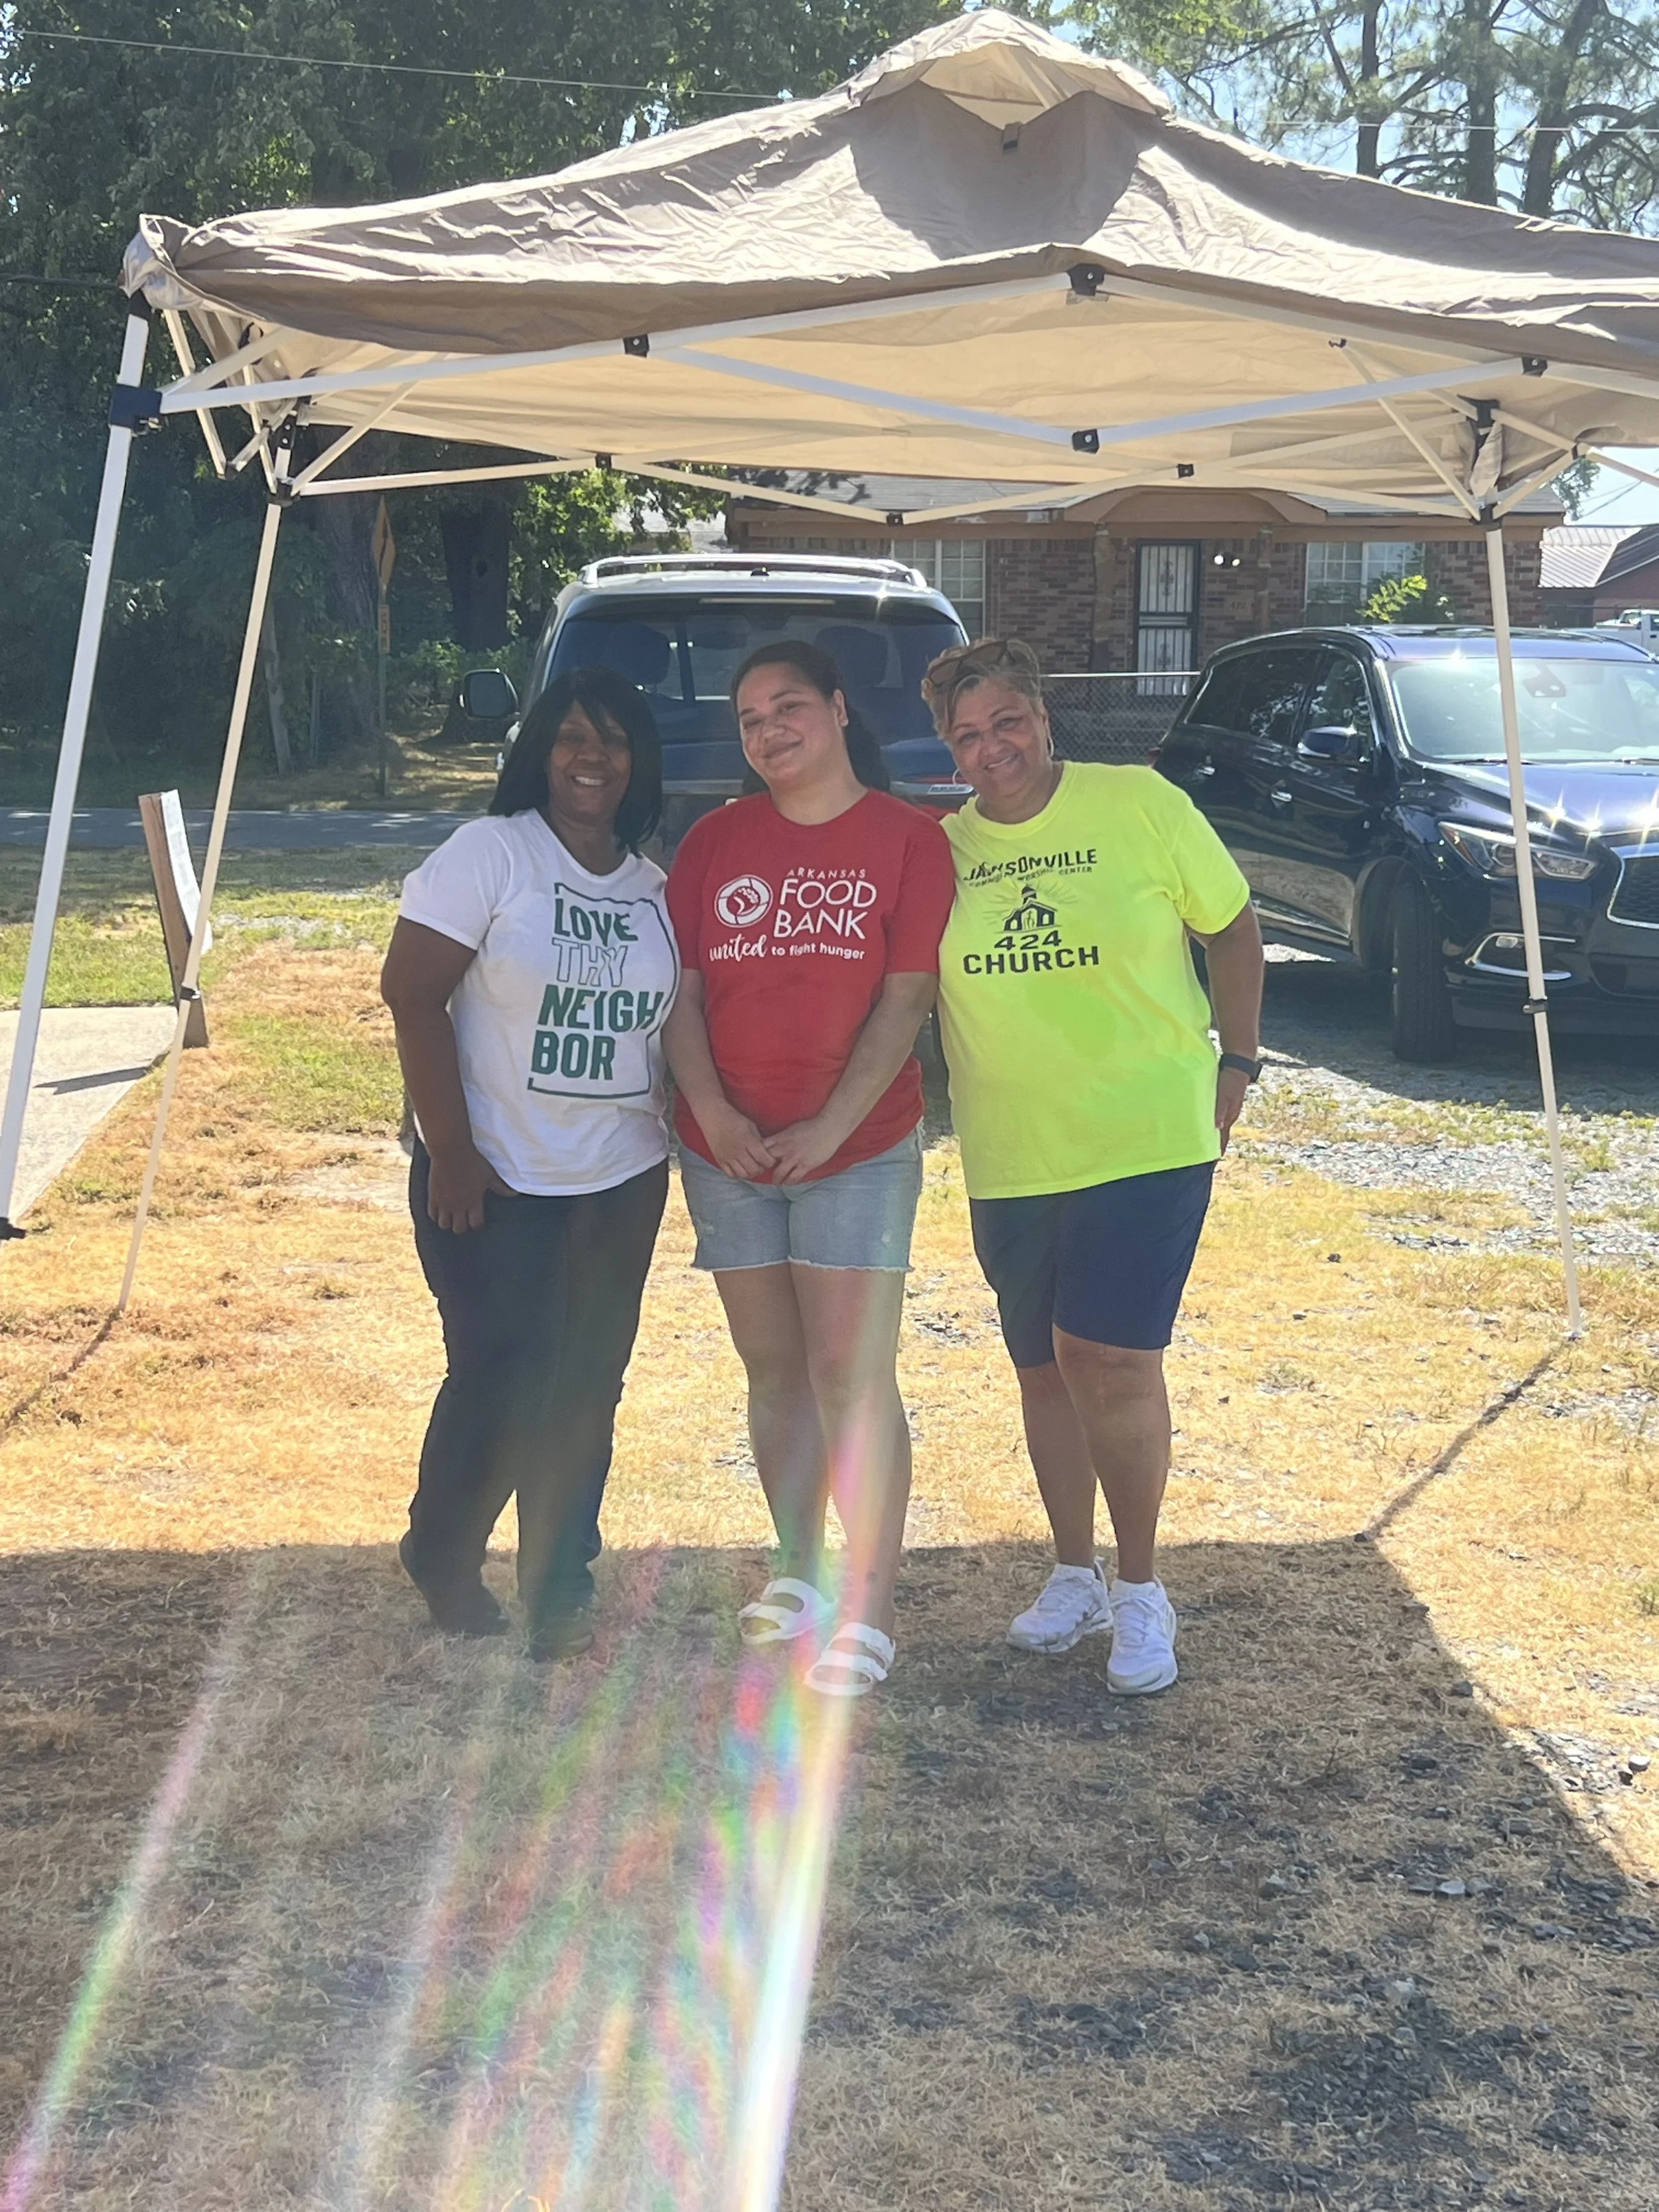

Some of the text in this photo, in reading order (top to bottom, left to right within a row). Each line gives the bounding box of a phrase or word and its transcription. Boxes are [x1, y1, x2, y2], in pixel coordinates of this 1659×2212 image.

[786, 867, 866, 880] ARKANSAS
[1059, 866, 1092, 875] CENTER
[780, 878, 877, 909] FOOD
[554, 898, 638, 947] LOVE
[773, 908, 866, 939] BANK
[709, 933, 865, 962] united to fight hunger
[994, 930, 1062, 951] 424
[551, 936, 628, 988] THY
[963, 946, 1099, 974] CHURCH
[538, 984, 664, 1033] NEIGH
[531, 1029, 616, 1080] BOR
